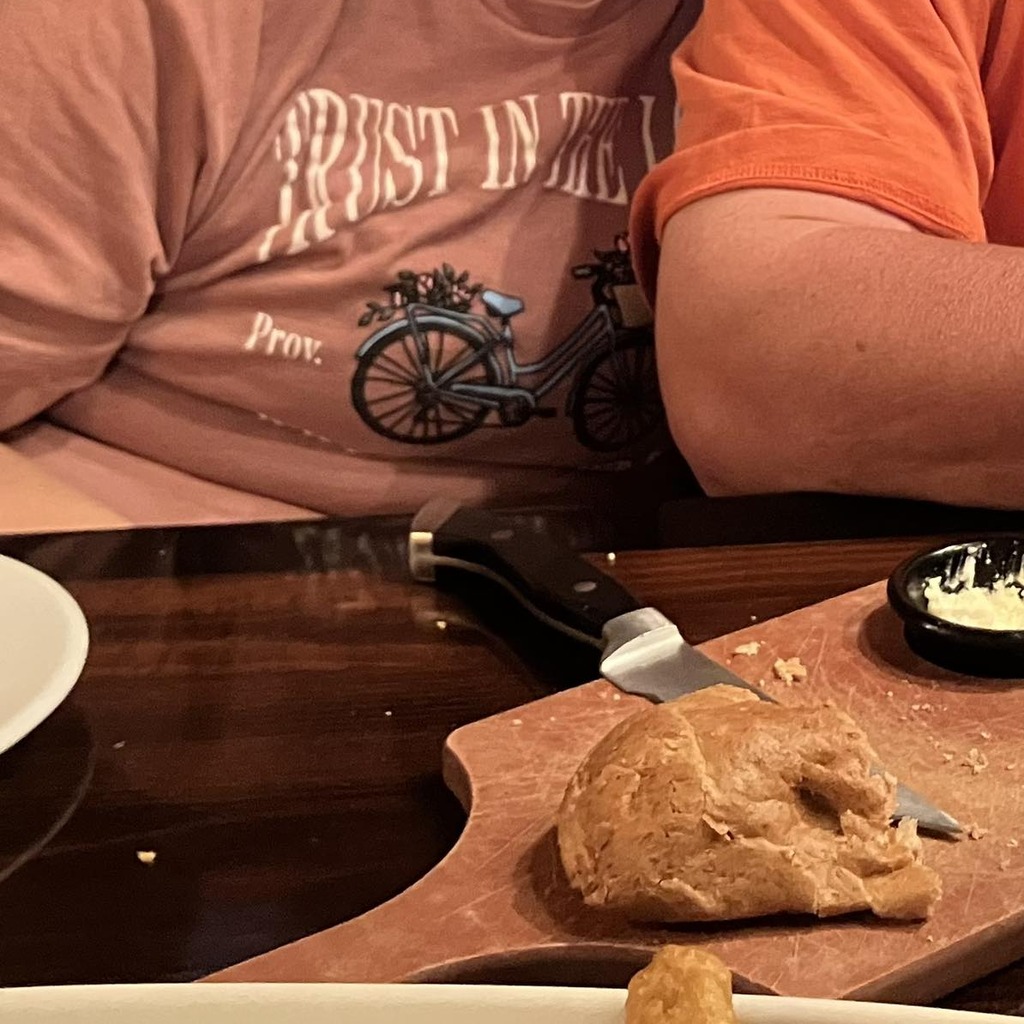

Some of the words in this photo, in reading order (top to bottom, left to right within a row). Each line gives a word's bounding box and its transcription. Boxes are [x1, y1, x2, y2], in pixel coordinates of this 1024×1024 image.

[478, 94, 539, 190] IN
[543, 90, 629, 206] THE
[244, 311, 323, 365] Prov.
